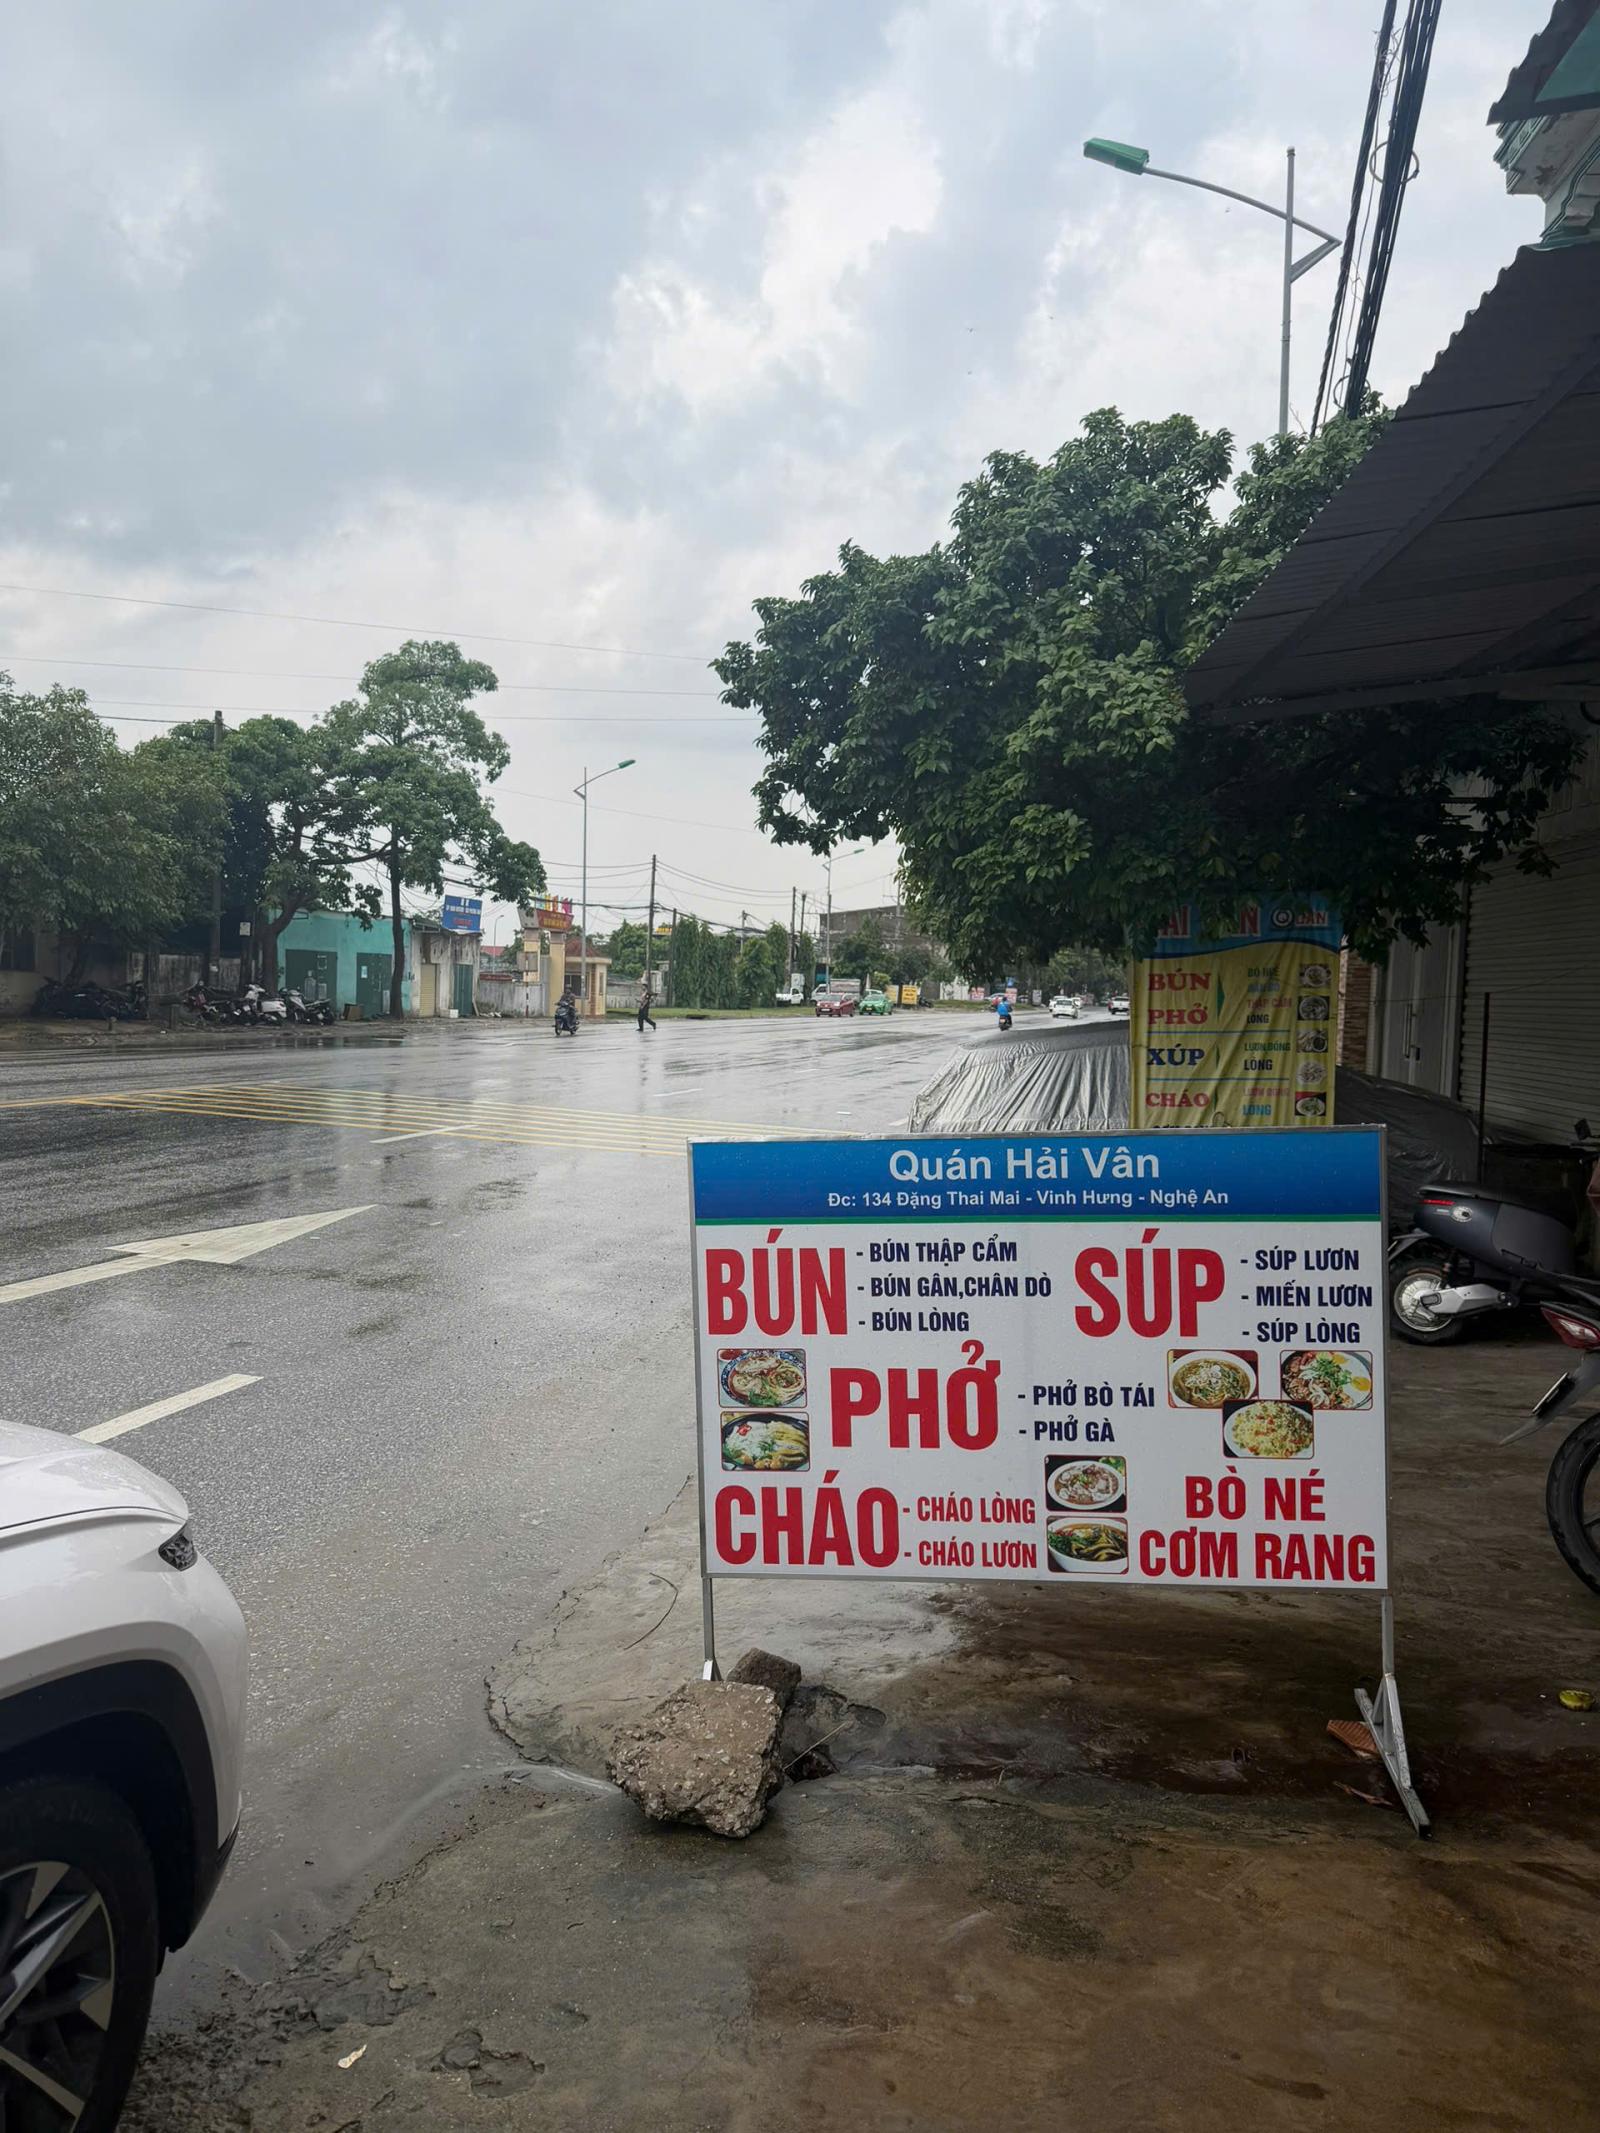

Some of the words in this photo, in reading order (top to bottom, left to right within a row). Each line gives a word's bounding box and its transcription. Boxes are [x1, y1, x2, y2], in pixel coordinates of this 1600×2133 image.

[1147, 968, 1211, 991] BÚN
[1147, 1003, 1209, 1025] PHỞ
[1147, 1043, 1205, 1065] XÚP
[1145, 1088, 1211, 1108] CHÁO
[889, 1148, 992, 1182] Quán
[1007, 1147, 1069, 1179] Hải
[1082, 1148, 1160, 1179] Vân
[828, 1193, 857, 1206] Đc:
[863, 1193, 891, 1206] 134
[897, 1192, 941, 1209] Đặng
[946, 1191, 985, 1205] Thai
[990, 1191, 1020, 1205] Mai
[1037, 1190, 1077, 1205] Vinh
[1083, 1190, 1133, 1208] Hưng
[1150, 1189, 1198, 1209] Nghệ
[1203, 1190, 1229, 1205] An
[870, 1238, 910, 1263] BÚN
[915, 1238, 966, 1267] THẬP
[972, 1233, 1017, 1262] CẨM
[1255, 1245, 1297, 1271] SÚP
[1304, 1248, 1359, 1271] LƯƠN
[706, 1228, 848, 1337] BÚN
[871, 1273, 911, 1297] BÚN
[1025, 1272, 1052, 1297] DÒ
[1074, 1228, 1225, 1338] SÚP
[1256, 1279, 1310, 1307] MIẾN
[1318, 1284, 1372, 1307] LƯƠN
[872, 1308, 912, 1332] BÚN
[918, 1307, 970, 1332] LÒNG
[1257, 1318, 1298, 1342] SÚP
[1306, 1317, 1360, 1343] LÒNG
[830, 1339, 1001, 1450] PHỞ
[1033, 1379, 1077, 1407] PHỞ
[1084, 1381, 1113, 1407] BÒ
[1120, 1382, 1155, 1407] TÁI
[1034, 1414, 1078, 1442] PHỞ
[1085, 1417, 1115, 1442] GÀ
[1185, 1465, 1246, 1520] BÒ
[1264, 1468, 1326, 1521] NÉ
[715, 1470, 900, 1567] CHÁO
[917, 1491, 973, 1522] CHÁO
[980, 1491, 1036, 1524] LÒNG
[918, 1536, 974, 1566] CHÁO
[981, 1540, 1037, 1568] LƯƠN
[1139, 1526, 1239, 1578] CƠM
[1255, 1532, 1376, 1582] RANG
